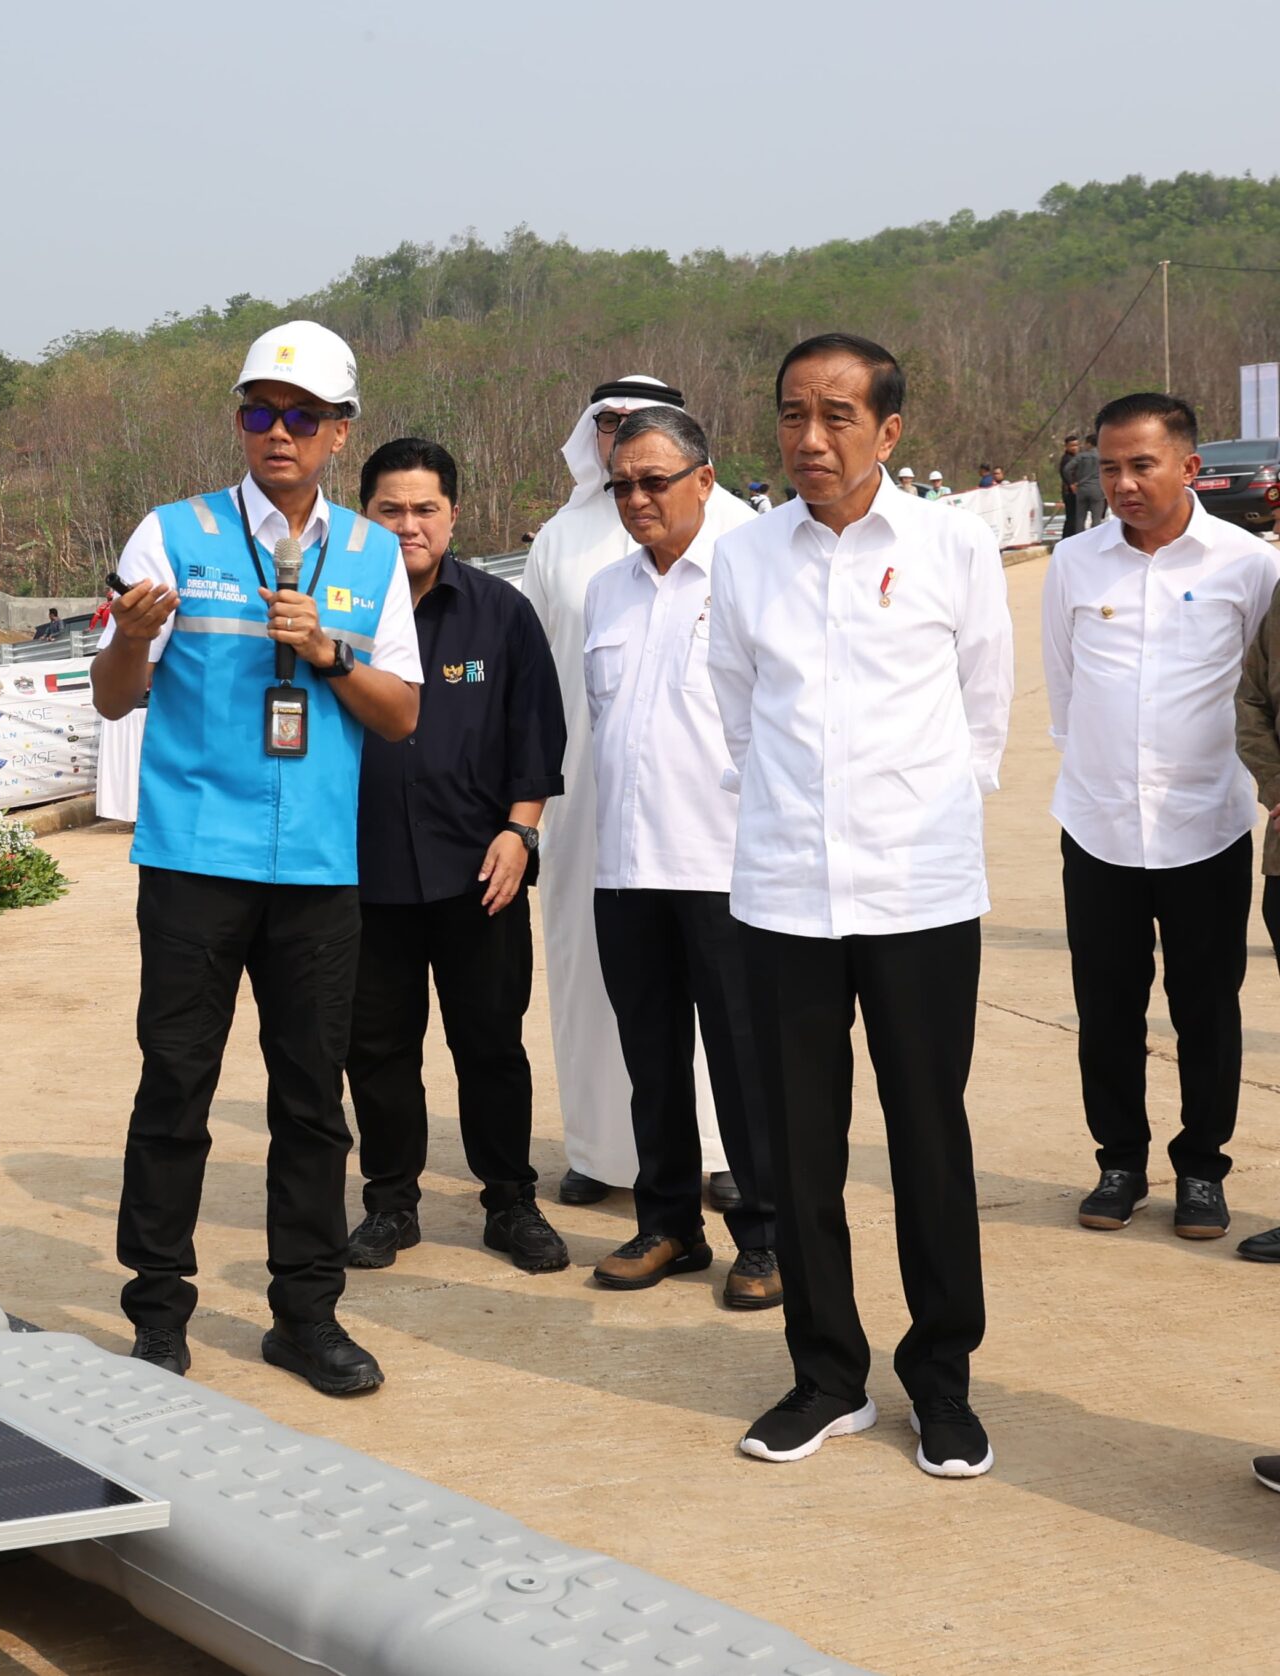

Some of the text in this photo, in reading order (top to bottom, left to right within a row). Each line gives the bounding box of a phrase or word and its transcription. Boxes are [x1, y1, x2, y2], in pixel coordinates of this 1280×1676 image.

[187, 578, 240, 593] DIREKTUR UTAMA
[180, 587, 248, 603] DARMAWAN PRASODJO
[352, 596, 375, 609] PLN
